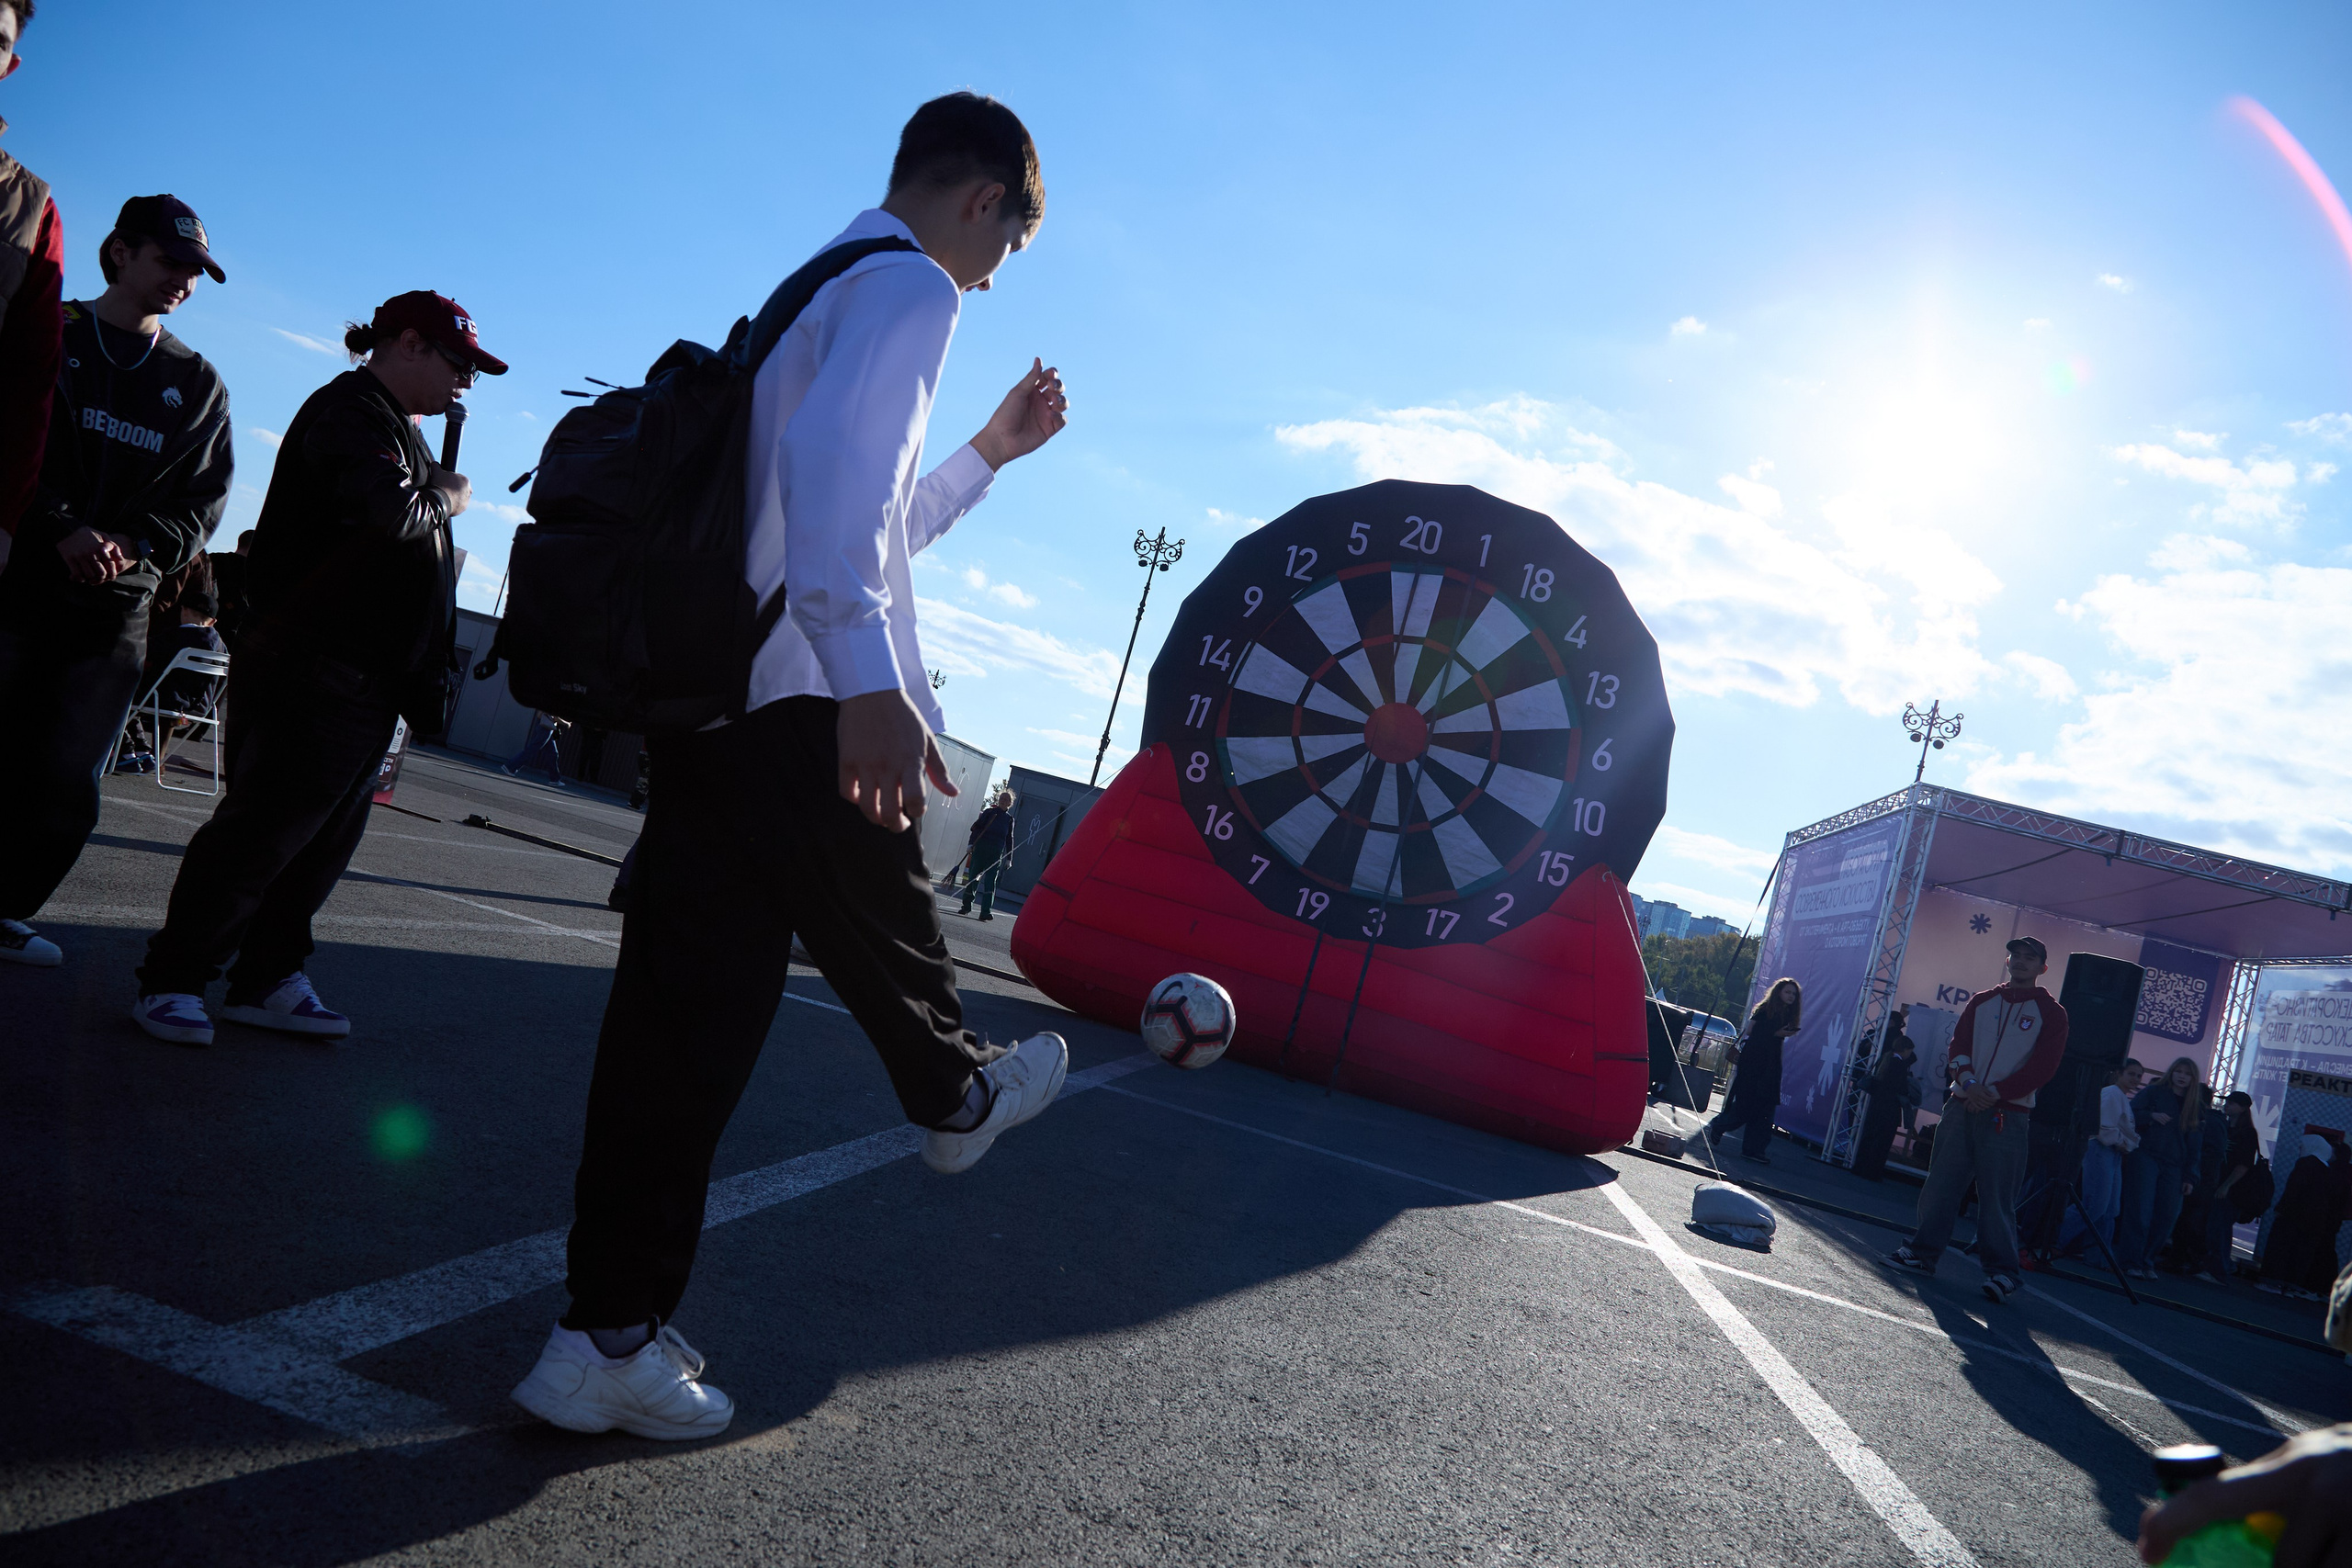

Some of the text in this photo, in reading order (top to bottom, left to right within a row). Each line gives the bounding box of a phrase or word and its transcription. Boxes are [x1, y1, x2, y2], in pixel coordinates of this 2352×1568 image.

[177, 219, 189, 227] FC
[83, 407, 164, 453] BEBOOM
[1348, 522, 1371, 555] 5
[1400, 516, 1442, 554] 20
[1480, 535, 1492, 567] 1
[1285, 546, 1317, 581] 12
[1521, 563, 1555, 602] 18
[1243, 586, 1262, 617] 9
[1565, 615, 1587, 649] 4
[1199, 635, 1231, 671] 14
[1587, 671, 1620, 708] 13
[1185, 694, 1212, 728] 11
[1186, 751, 1209, 782] 8
[1592, 739, 1612, 771] 6
[1204, 805, 1234, 840] 16
[1573, 798, 1605, 836] 10
[1249, 854, 1270, 885] 7
[1538, 851, 1574, 886] 15
[1296, 888, 1329, 919] 19
[1487, 893, 1514, 927] 2
[1363, 908, 1386, 937] 3
[1426, 908, 1460, 939] 17
[1937, 984, 1974, 1005] КР
